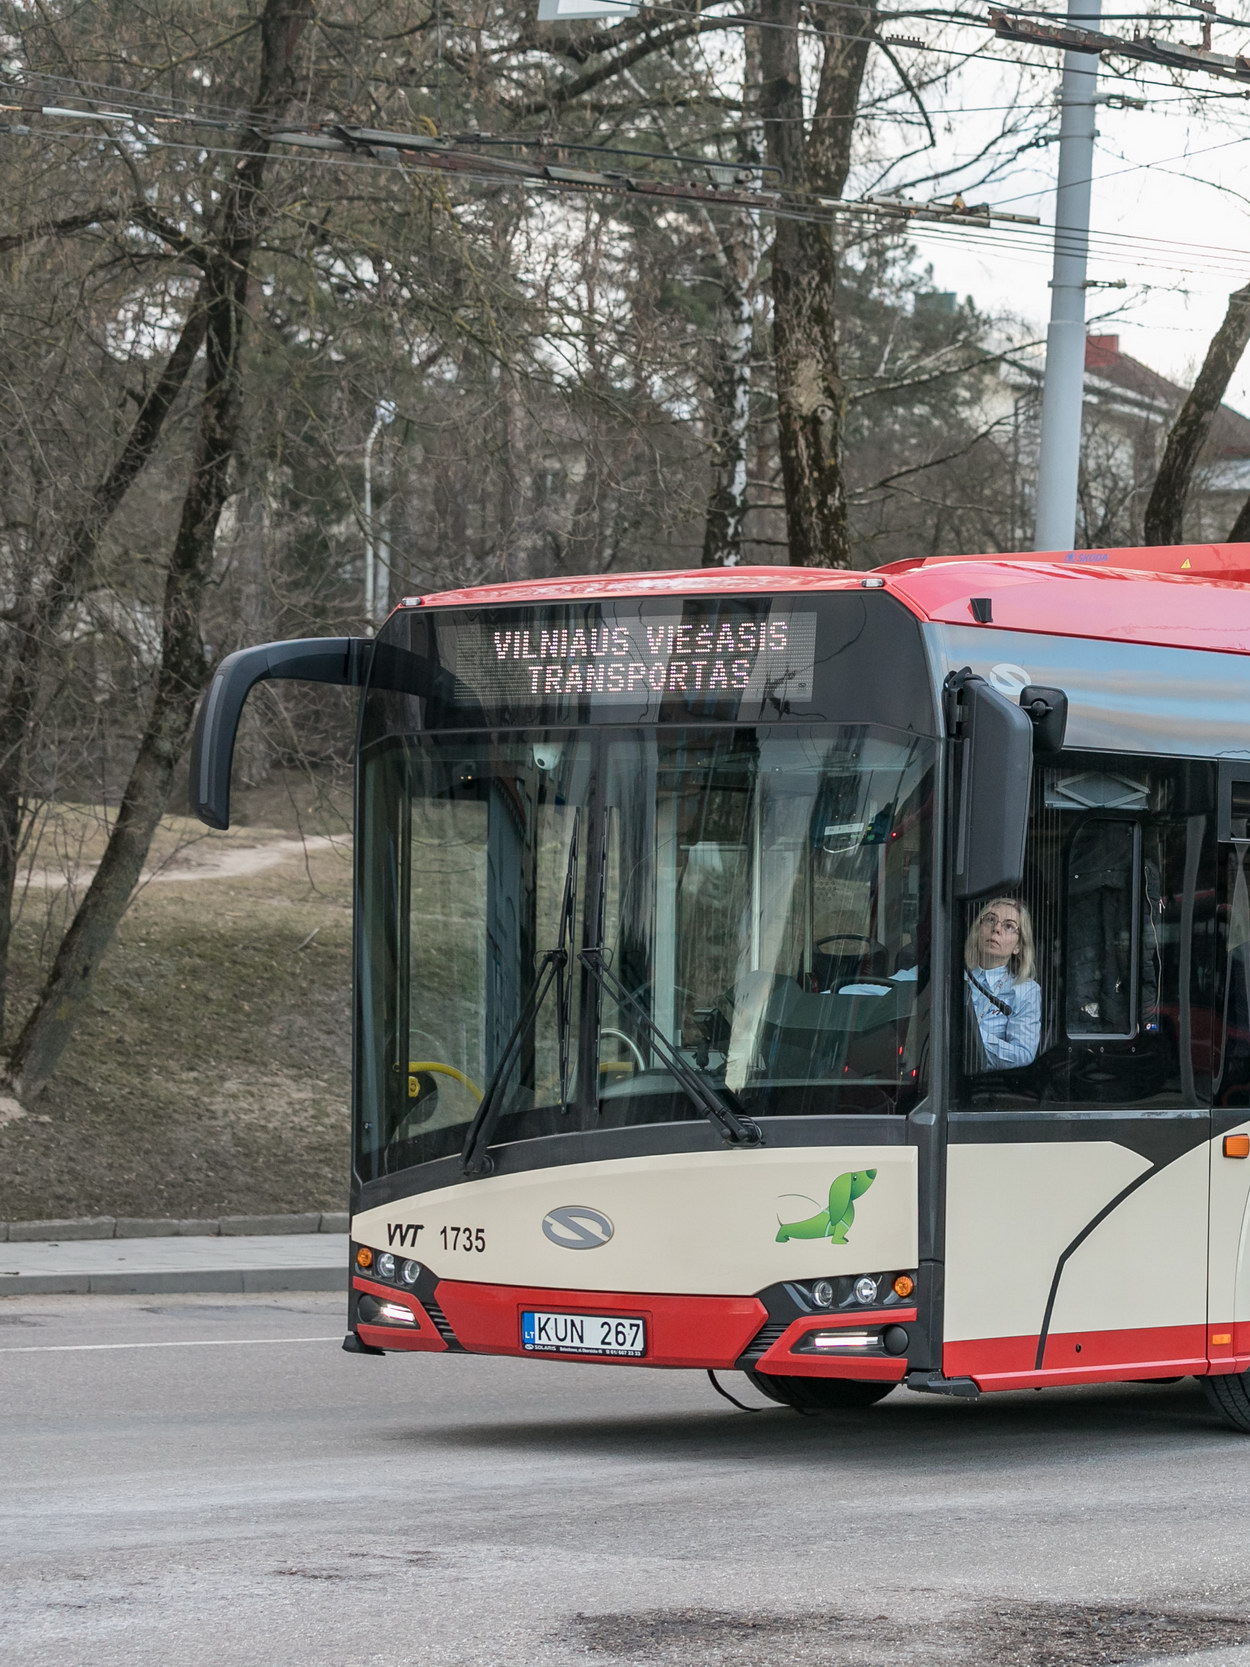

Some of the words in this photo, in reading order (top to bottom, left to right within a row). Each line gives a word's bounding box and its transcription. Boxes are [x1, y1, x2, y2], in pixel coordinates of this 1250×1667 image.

[494, 626, 629, 659] VILNIAUS
[647, 621, 788, 654] VIEŠASIS
[528, 659, 750, 694] TRANSPORTAS
[387, 1223, 424, 1247] VVT
[440, 1226, 486, 1252] 1735
[524, 1331, 534, 1339] LT
[538, 1316, 584, 1344] KUN
[600, 1321, 640, 1347] 267
